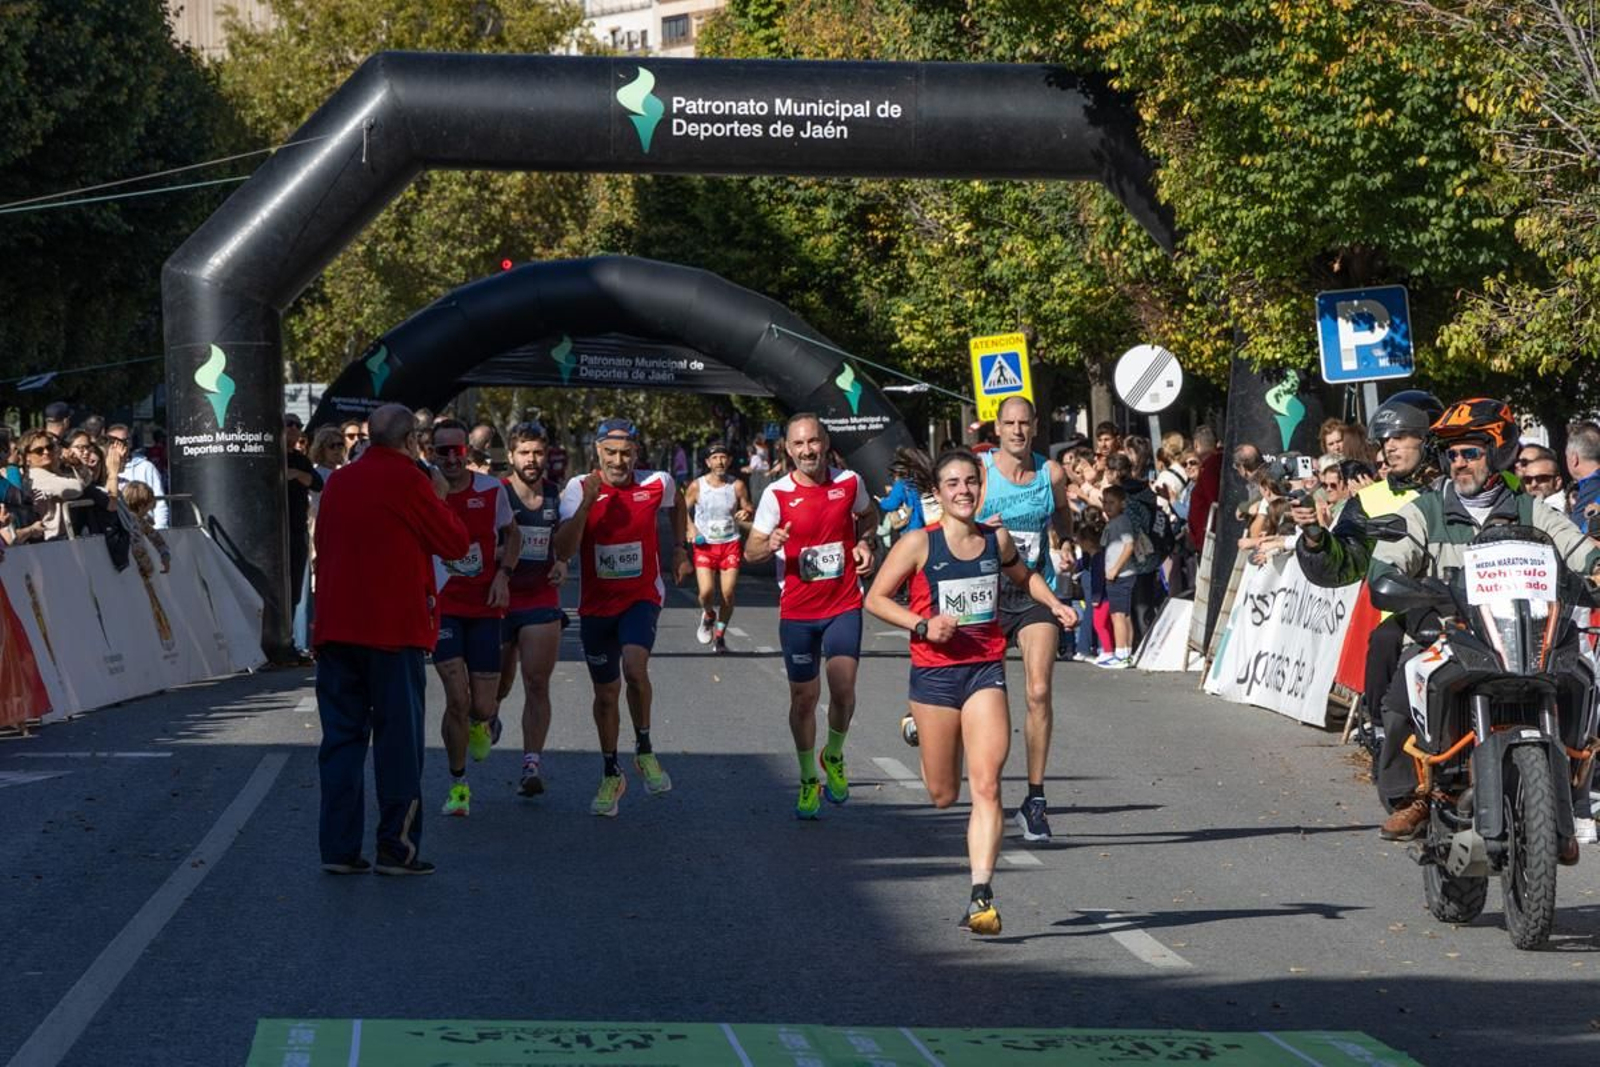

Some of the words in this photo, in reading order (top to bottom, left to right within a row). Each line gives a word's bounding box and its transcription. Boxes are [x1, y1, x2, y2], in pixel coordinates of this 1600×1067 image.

[672, 97, 769, 115] Patronato
[775, 98, 870, 120] Municipal
[876, 100, 902, 118] de
[672, 119, 763, 140] Deportes
[769, 121, 794, 138] de
[800, 121, 848, 139] Jaén
[1336, 299, 1391, 372] P
[580, 354, 632, 367] Patronato
[635, 356, 687, 370] Municipal
[689, 359, 704, 370] de
[580, 366, 629, 379] Deportes
[631, 369, 645, 380] de
[175, 433, 214, 446] Patronato
[215, 431, 262, 443] Municipal
[183, 444, 225, 457] Deportes
[226, 443, 240, 453] de
[241, 442, 265, 453] Jaén
[619, 553, 638, 564] 650
[822, 553, 841, 564] 637
[1475, 561, 1496, 569] MEDIA
[971, 590, 993, 603] 651
